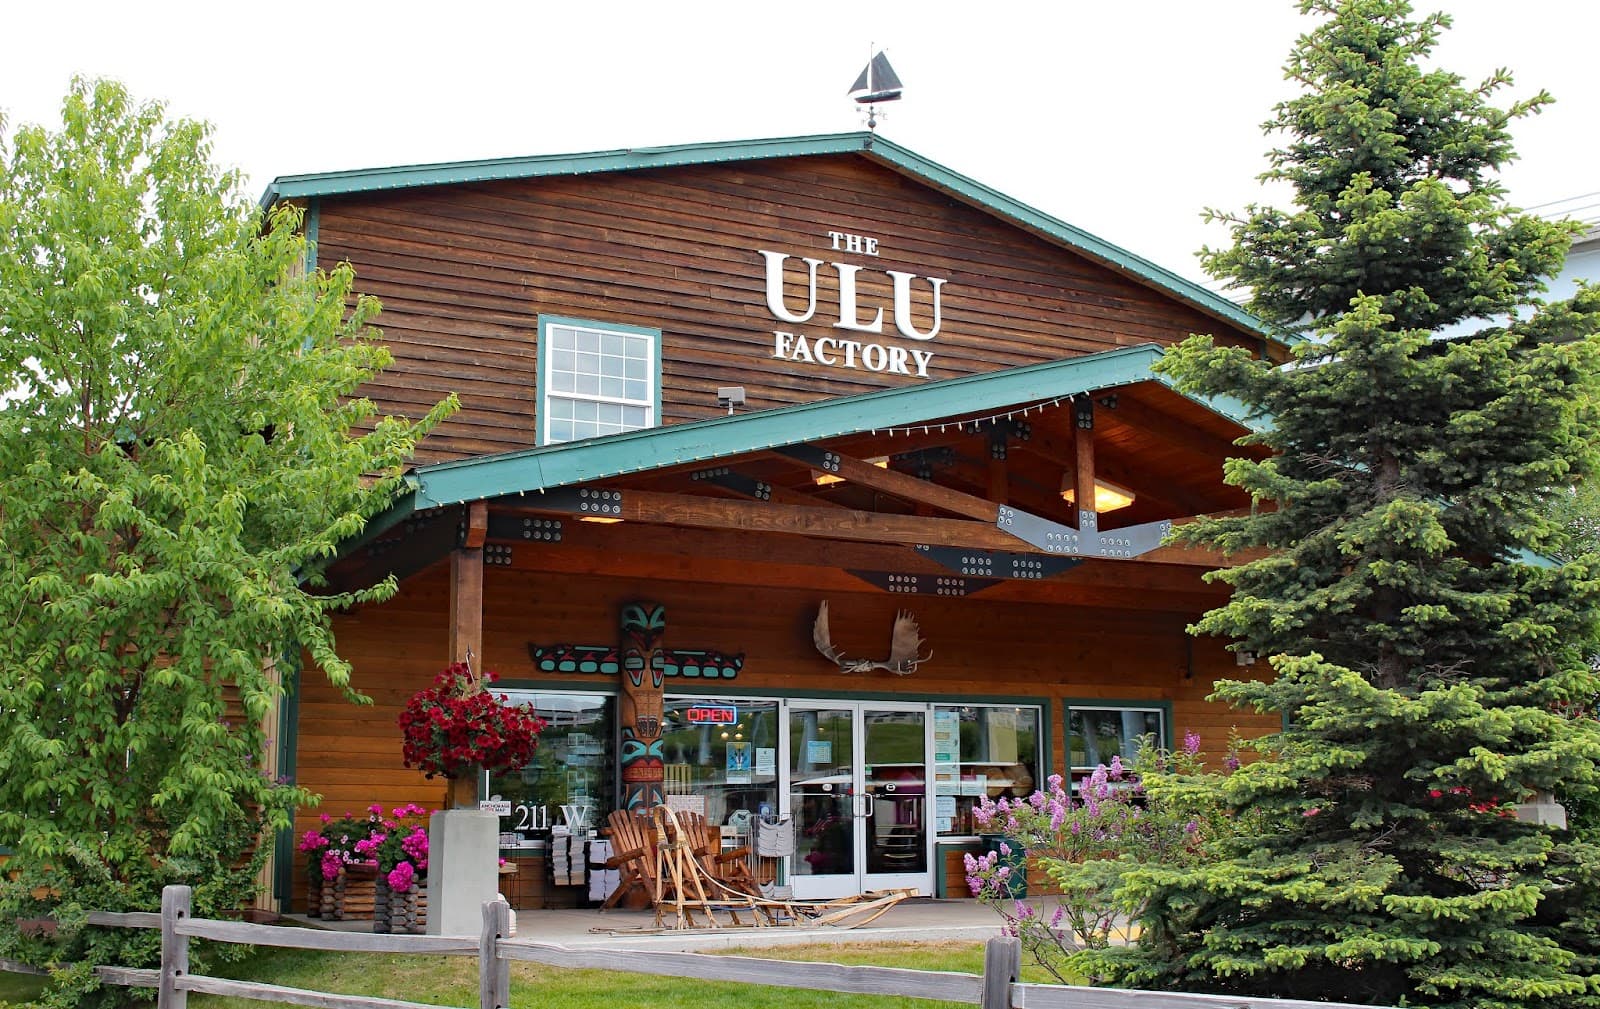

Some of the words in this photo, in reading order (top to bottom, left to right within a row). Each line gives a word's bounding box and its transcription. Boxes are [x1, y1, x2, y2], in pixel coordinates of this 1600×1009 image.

[828, 231, 880, 256] THE
[757, 250, 948, 341] ULU
[772, 331, 935, 378] FACTORY
[687, 708, 733, 722] OPEN
[514, 805, 549, 830] 211
[559, 805, 595, 829] W
